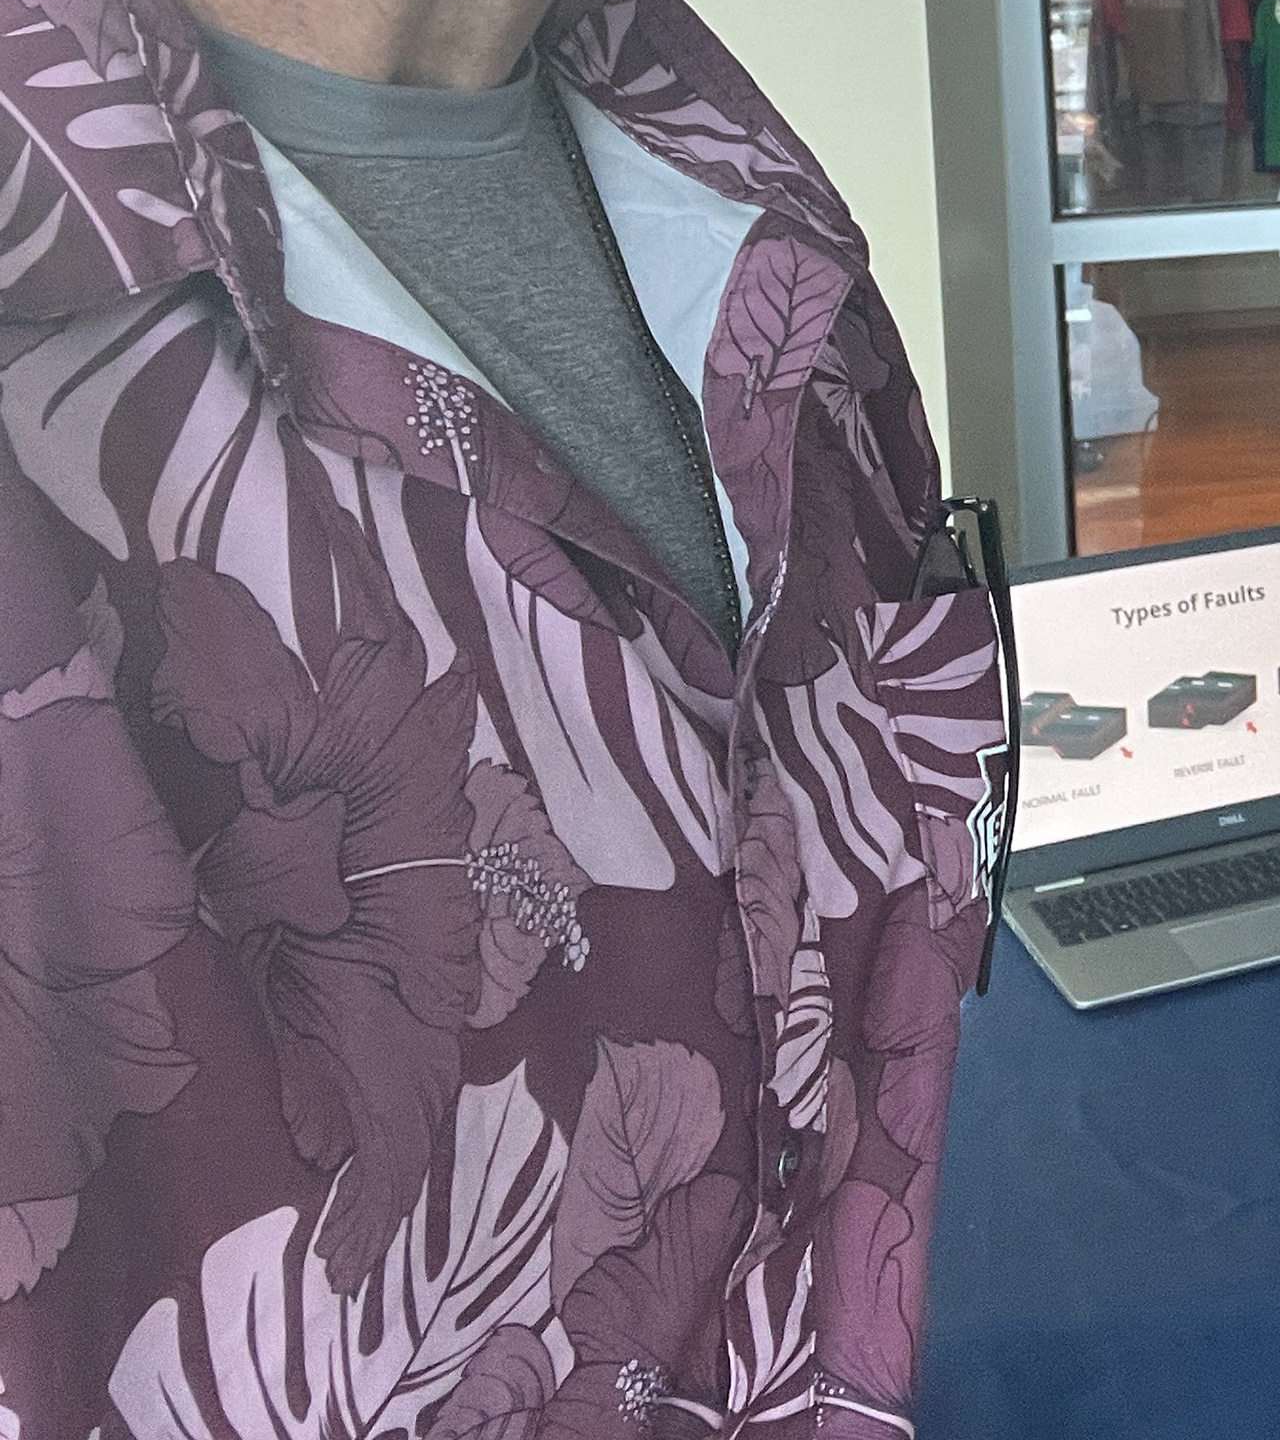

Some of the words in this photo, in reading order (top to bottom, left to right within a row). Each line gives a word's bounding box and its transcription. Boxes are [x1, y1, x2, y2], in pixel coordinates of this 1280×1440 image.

[1111, 603, 1172, 628] Types
[1178, 593, 1199, 614] of
[1204, 585, 1265, 608] Faults
[1021, 791, 1069, 809] NORMAL
[1071, 784, 1101, 800] FAULT
